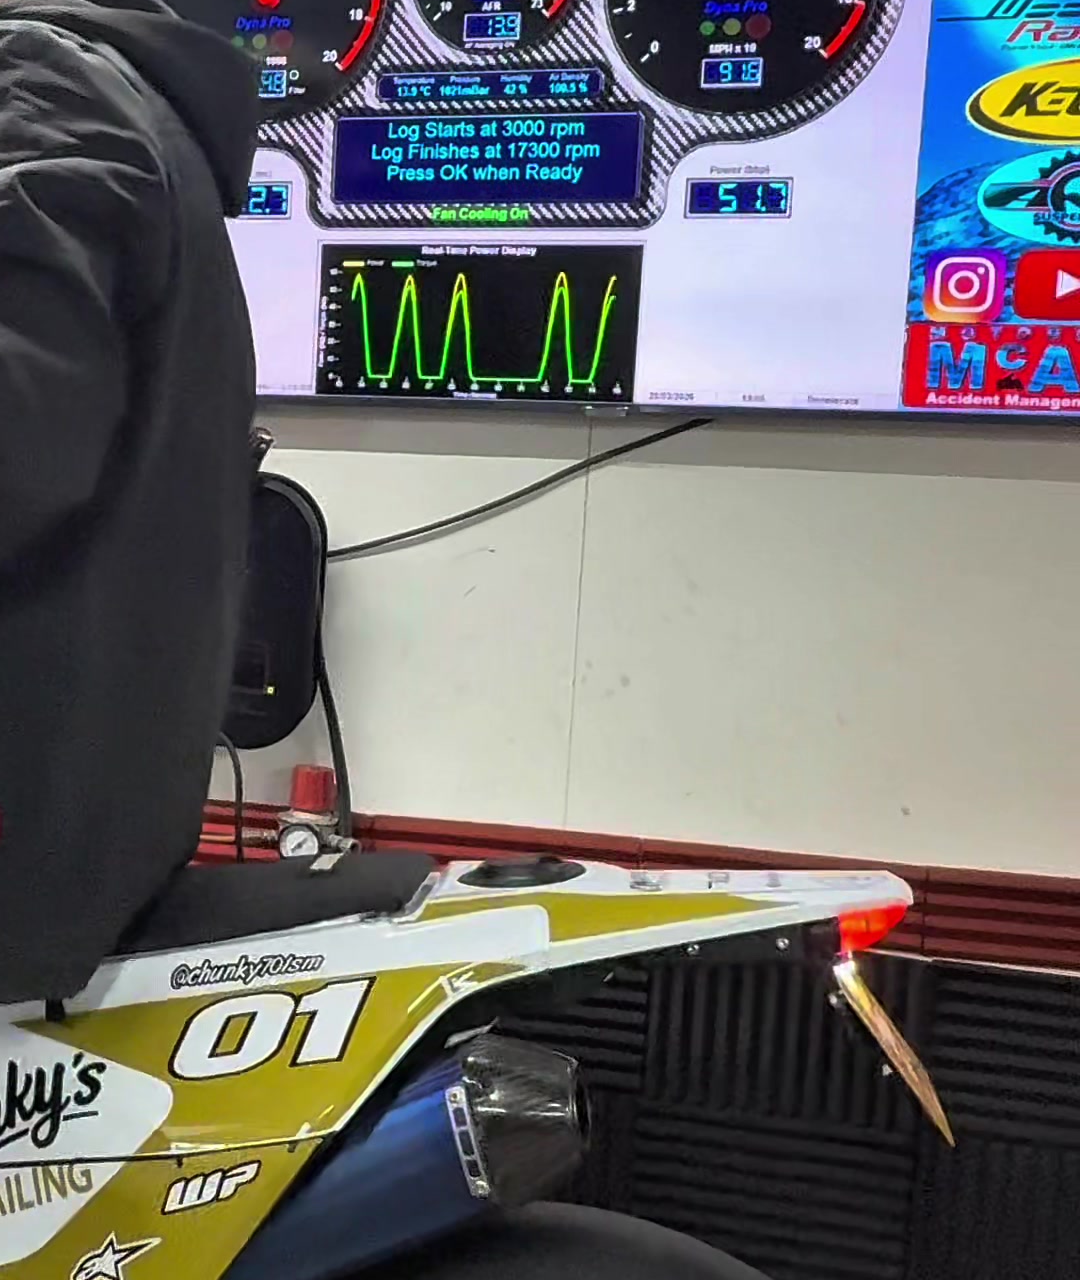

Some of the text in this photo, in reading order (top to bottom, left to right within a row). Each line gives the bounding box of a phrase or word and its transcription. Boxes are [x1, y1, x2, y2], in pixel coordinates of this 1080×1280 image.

[626, 0, 637, 12] 2
[703, 0, 769, 17] Dyna Pro
[235, 15, 292, 30] Dyna Pro
[650, 40, 659, 54] 0
[803, 36, 822, 50] 20
[322, 50, 338, 63] 20
[388, 120, 585, 141] Log Starts at 3000 rpm
[371, 142, 600, 163] Log Finishes at 17300 rpm
[386, 162, 583, 183] Press OK when Ready
[432, 206, 529, 222] Fan Cooling On
[469, 245, 499, 257] Power
[500, 245, 538, 257] Display
[925, 392, 1001, 406] Accident
[167, 975, 378, 1081] 01
[160, 1159, 263, 1216] WP
